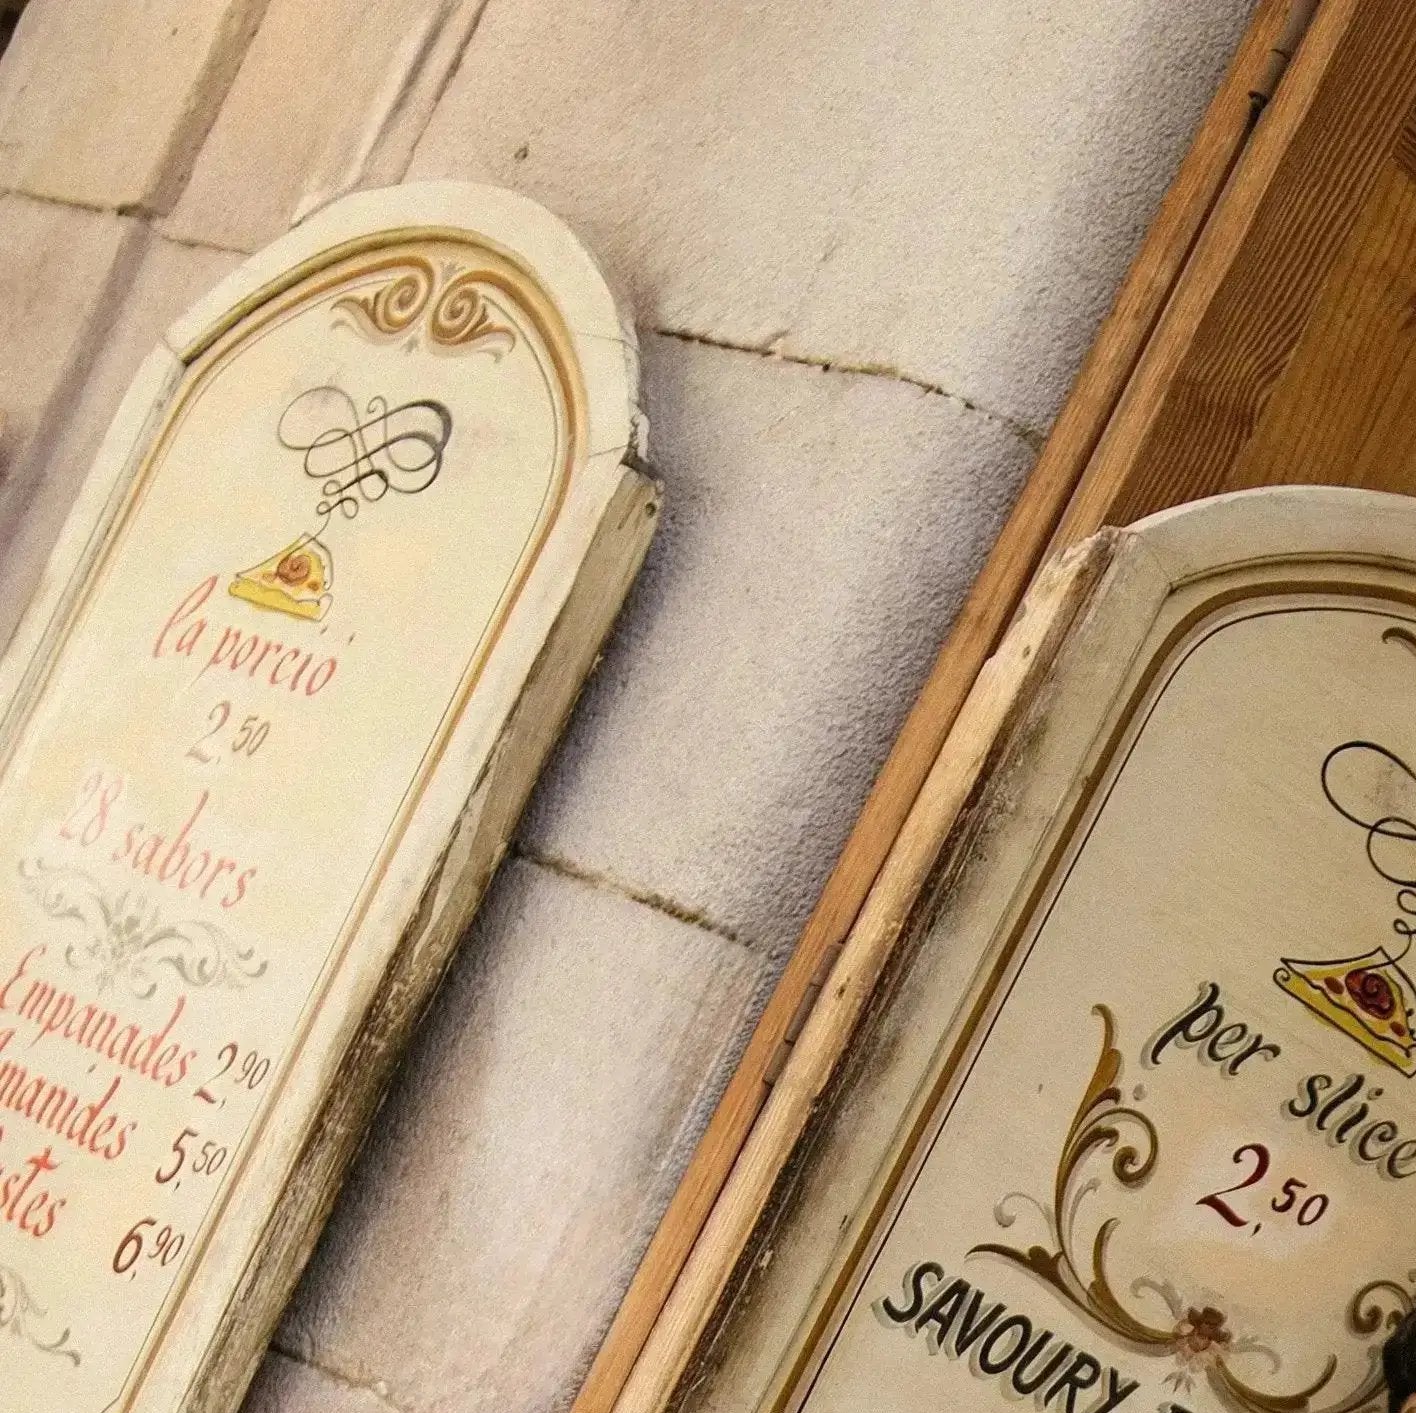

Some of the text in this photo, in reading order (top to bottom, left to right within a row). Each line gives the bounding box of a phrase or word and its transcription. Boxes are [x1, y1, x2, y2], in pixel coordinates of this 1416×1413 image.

[152, 574, 218, 658] la
[112, 789, 257, 908] sabors
[0, 944, 197, 1087] Empanades
[1148, 981, 1282, 1076] per
[0, 1028, 137, 1160] manides
[0, 1126, 67, 1237] stes
